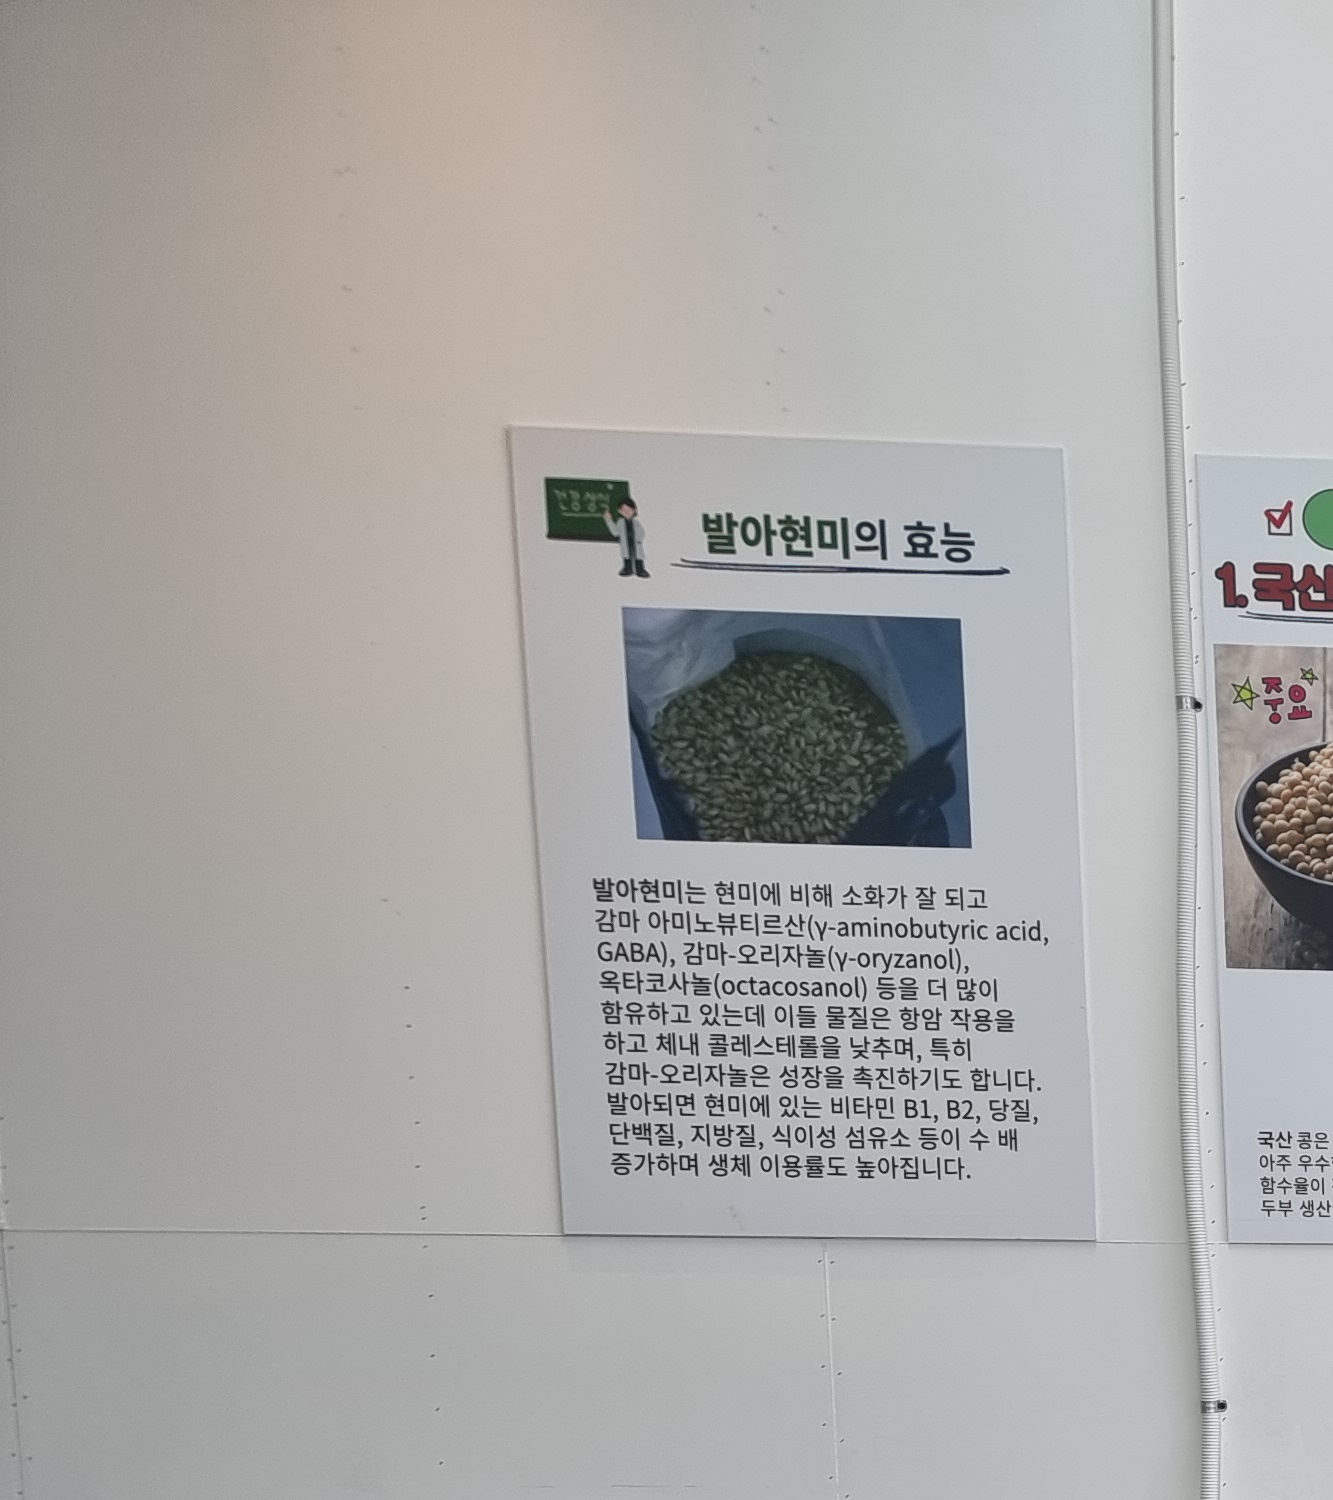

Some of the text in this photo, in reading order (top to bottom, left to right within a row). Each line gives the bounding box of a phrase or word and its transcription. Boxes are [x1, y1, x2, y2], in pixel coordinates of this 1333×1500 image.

[701, 510, 976, 562] 발아현미의 효능
[592, 877, 989, 912] 발아현미는 현미에 비해 소화가 잘 되고
[595, 908, 641, 934] 감마
[996, 919, 1049, 947] acid,
[597, 940, 676, 968] GABA),
[598, 970, 998, 1003] 옥타코사놀(octacosanol) 등을 더 많이
[600, 1000, 1016, 1033] 함유하고 있는데 이들 물질은 항암 작용을
[602, 1031, 972, 1064] 하고 체내 콜레스테롤을 낮추며, 특히
[605, 1061, 1042, 1093] 감마-오리자놀은 성장을 촉진하기도 합니다.
[607, 1091, 1039, 1126] 발아되면 현미에 있는 비타민 B1, B2, 당질,
[609, 1121, 1018, 1152] 단백질, 지방질, 식이성 섬유소 등이 수 배
[1256, 1130, 1294, 1150] 국산
[1296, 1131, 1330, 1150] 콩은
[610, 1152, 971, 1181] 증가하며 생체 이용률도 높아집니다.
[1259, 1153, 1293, 1173] 아주
[1259, 1175, 1325, 1196] 함수율이
[1260, 1199, 1294, 1218] 두부
